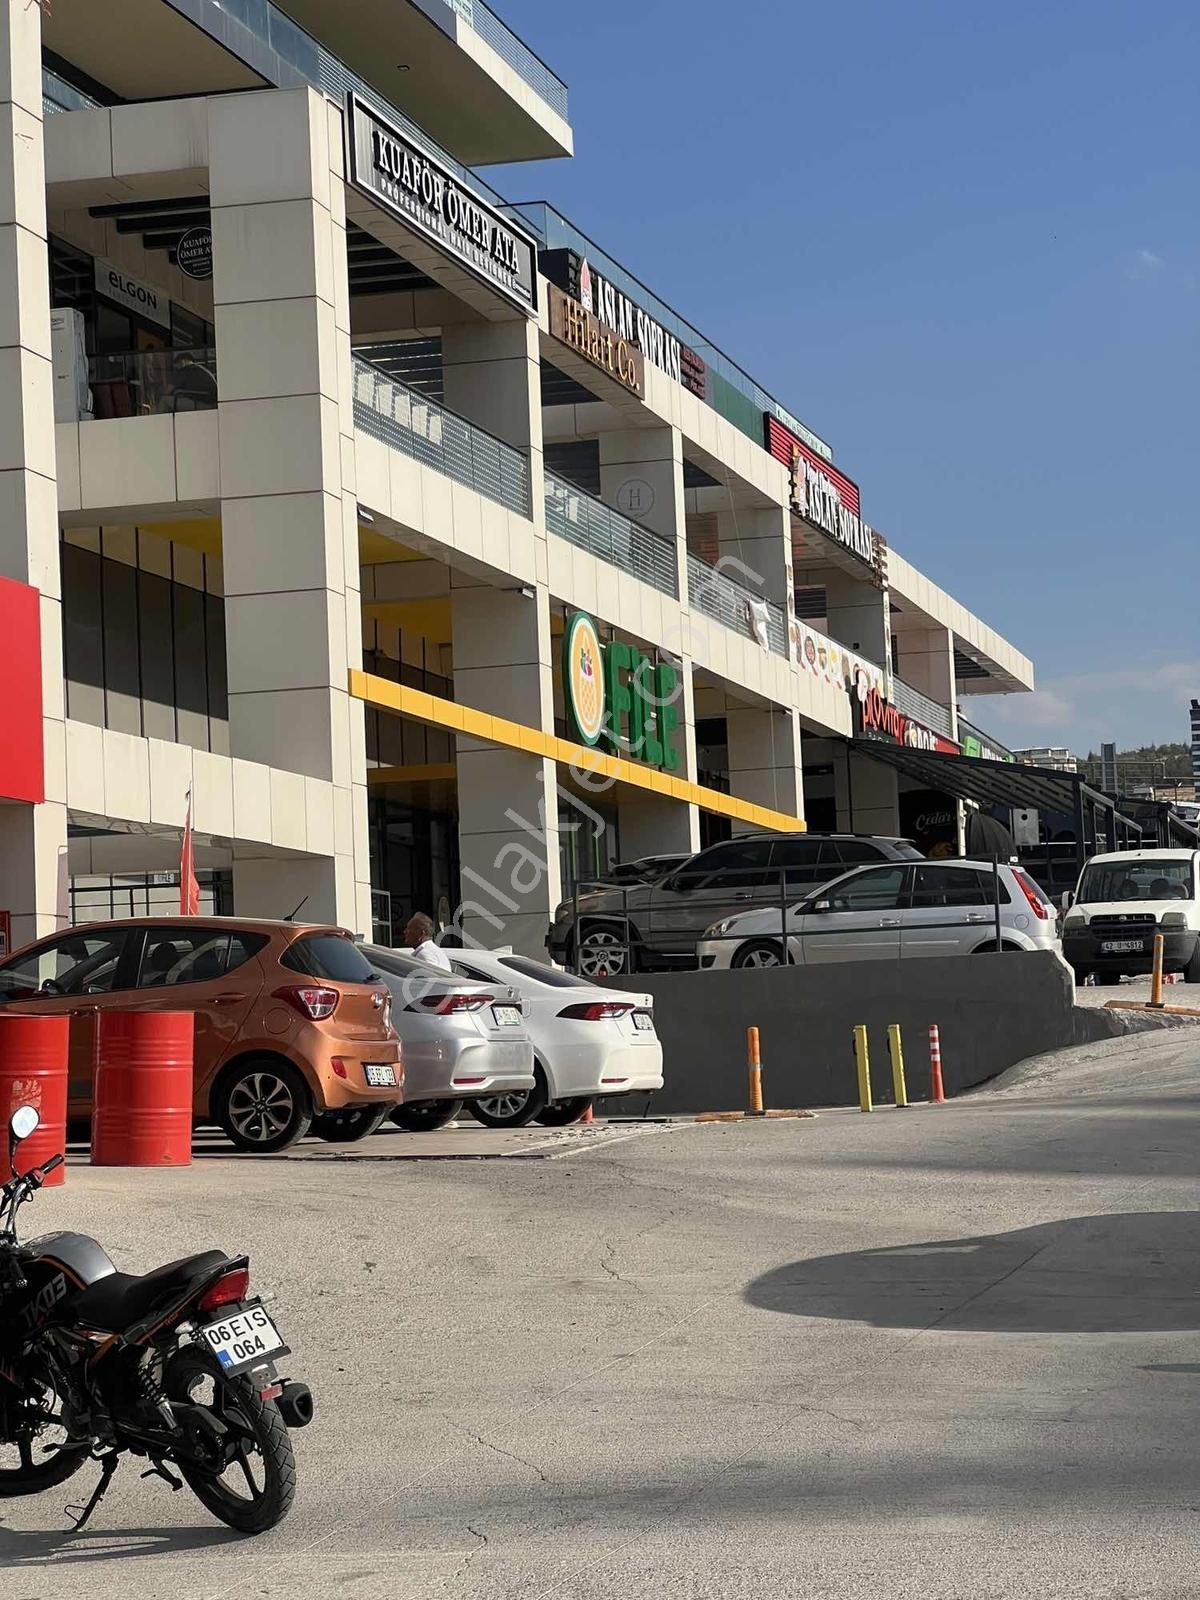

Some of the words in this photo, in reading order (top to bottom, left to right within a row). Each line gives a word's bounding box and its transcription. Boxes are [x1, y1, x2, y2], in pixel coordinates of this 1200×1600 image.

[378, 130, 442, 213] KUAFÖR
[448, 180, 493, 252] ÖMER
[495, 227, 520, 276] ATA
[380, 177, 447, 239] PROFESSIONAL
[597, 275, 634, 341] ASLAN
[565, 297, 614, 371] Hilart
[618, 340, 641, 391] Co.
[232, 1335, 266, 1360] 064
